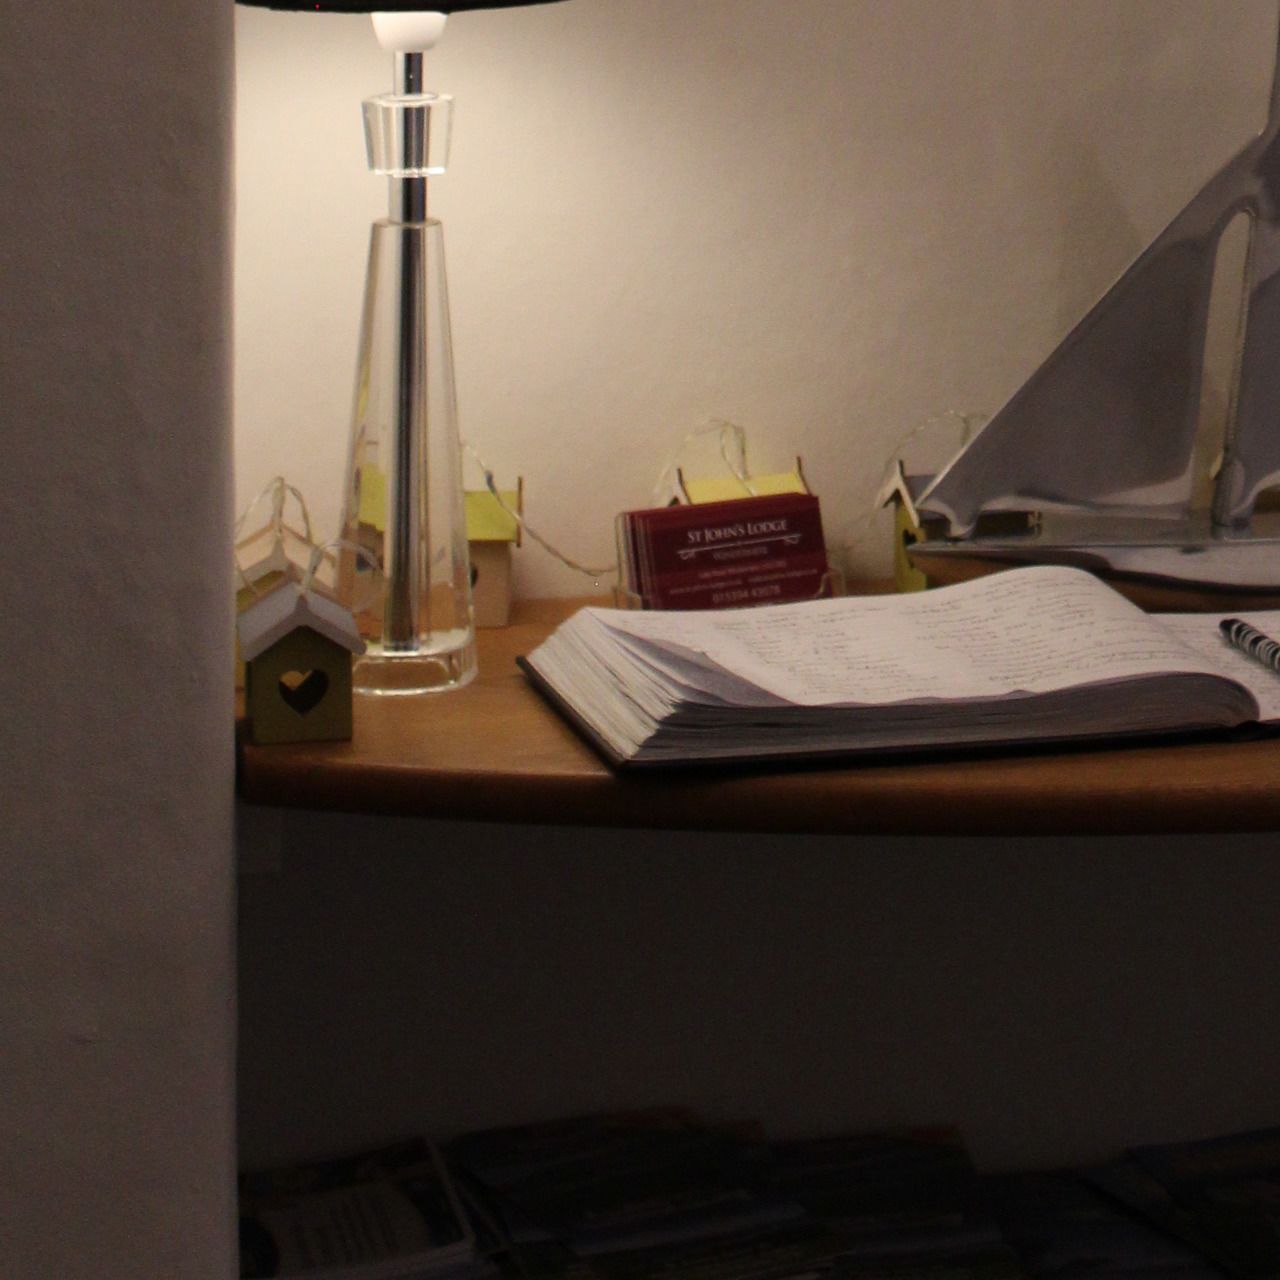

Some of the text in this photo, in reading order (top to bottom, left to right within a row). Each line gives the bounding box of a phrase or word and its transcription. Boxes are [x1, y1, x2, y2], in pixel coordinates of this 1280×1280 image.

[687, 520, 787, 543] ST JOHN'S LODGE
